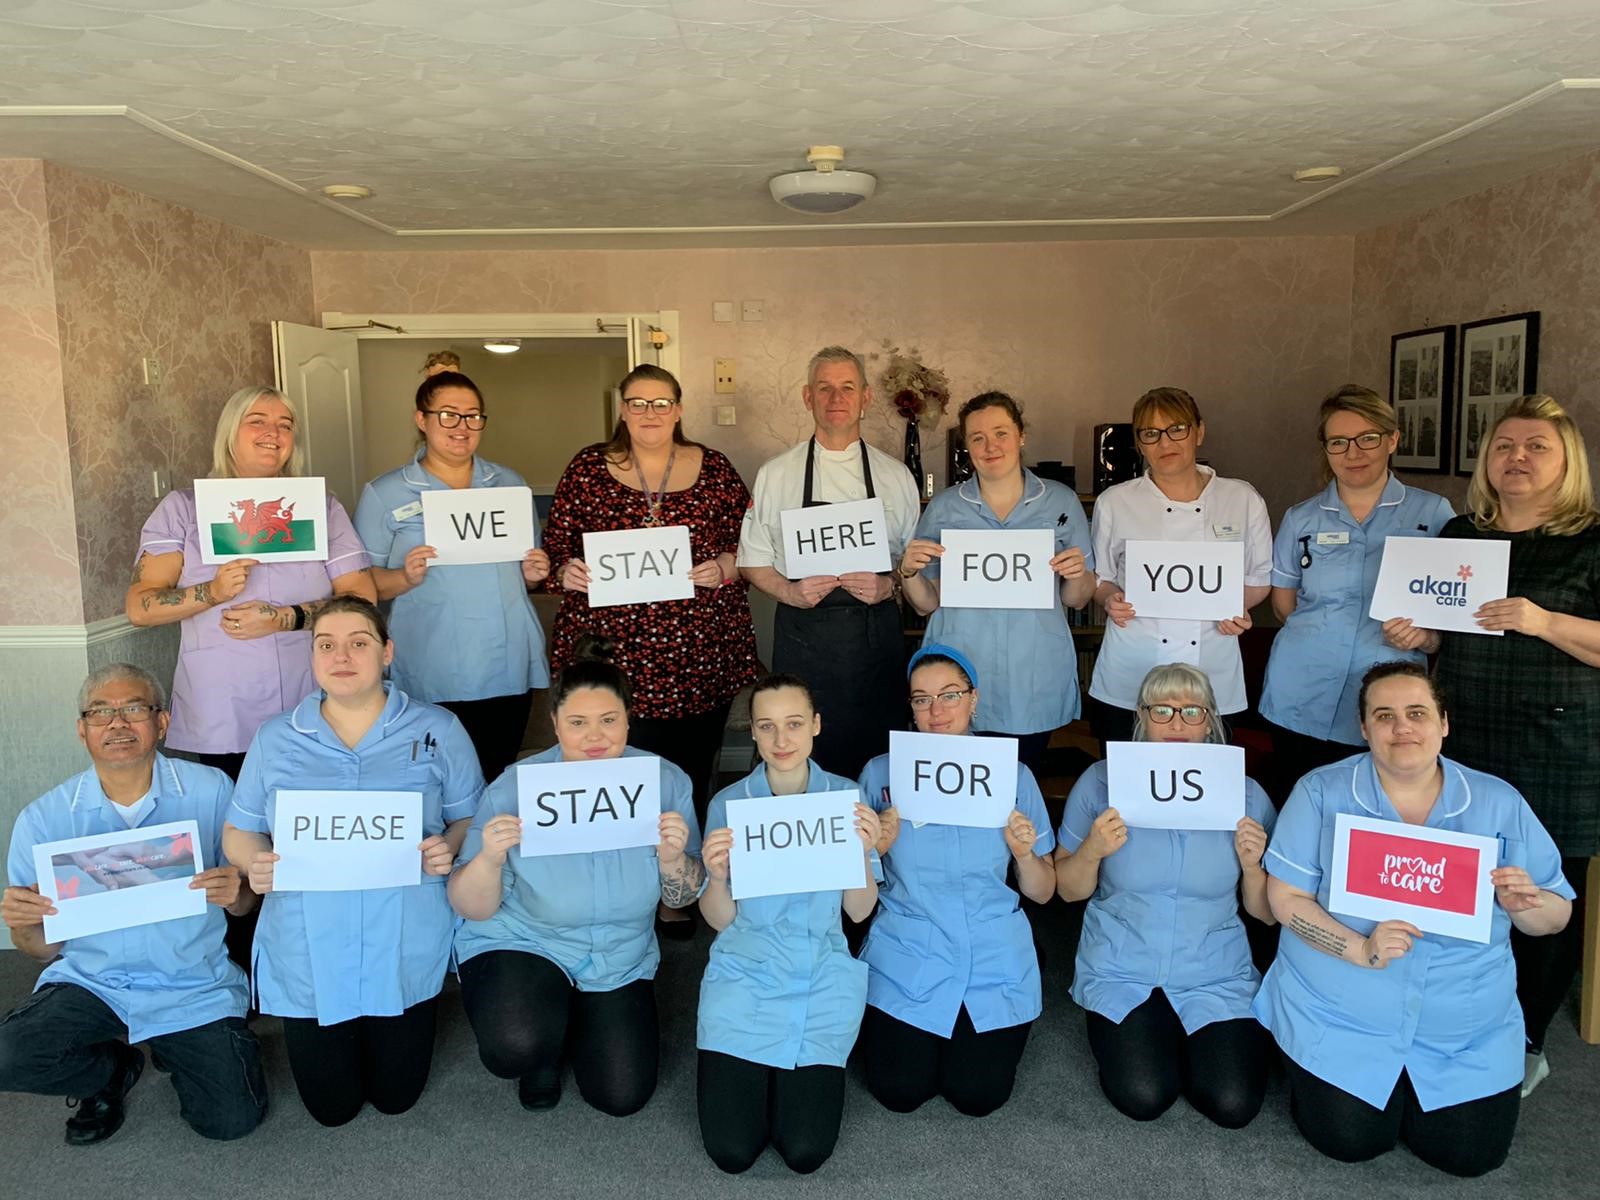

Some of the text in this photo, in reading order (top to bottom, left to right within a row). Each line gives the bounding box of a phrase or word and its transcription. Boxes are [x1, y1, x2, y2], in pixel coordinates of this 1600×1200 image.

[450, 510, 508, 541] WE
[796, 520, 876, 555] HERE
[599, 548, 679, 582] STAY
[963, 552, 1033, 582] FOR
[1143, 563, 1223, 594] YOU
[1409, 573, 1468, 597] akari
[1436, 596, 1467, 607] care
[914, 759, 992, 798] FOR
[1149, 768, 1204, 803] US
[536, 783, 645, 828] STAY
[293, 815, 405, 841] PLEASE
[745, 815, 847, 852] HOME
[1377, 871, 1445, 894] to care
